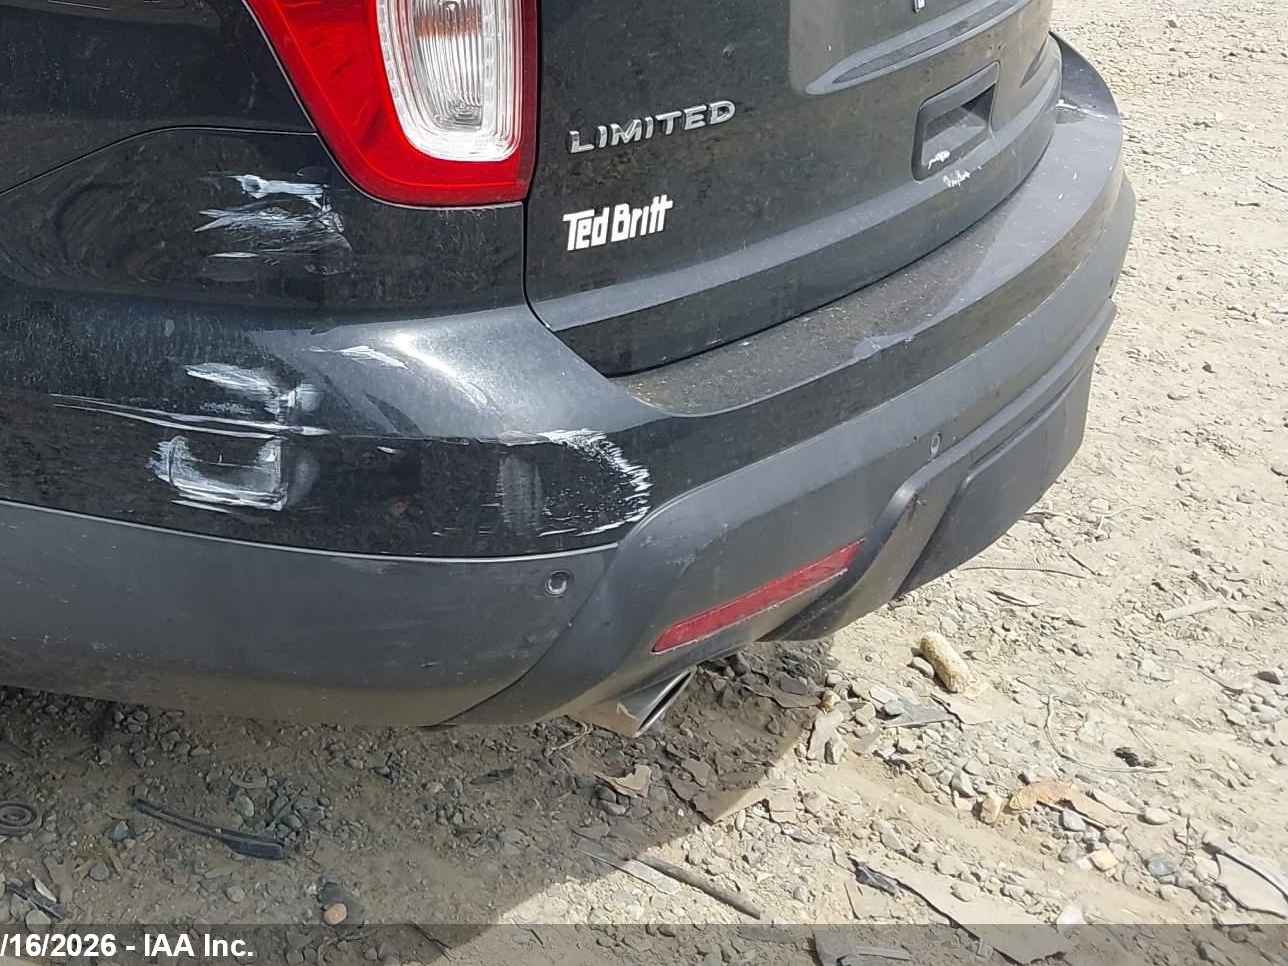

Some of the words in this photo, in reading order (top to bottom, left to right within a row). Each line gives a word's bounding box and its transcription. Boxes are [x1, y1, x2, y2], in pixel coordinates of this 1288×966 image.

[569, 100, 736, 153] LIMITED
[562, 206, 610, 251] Ted
[610, 194, 674, 243] Britt
